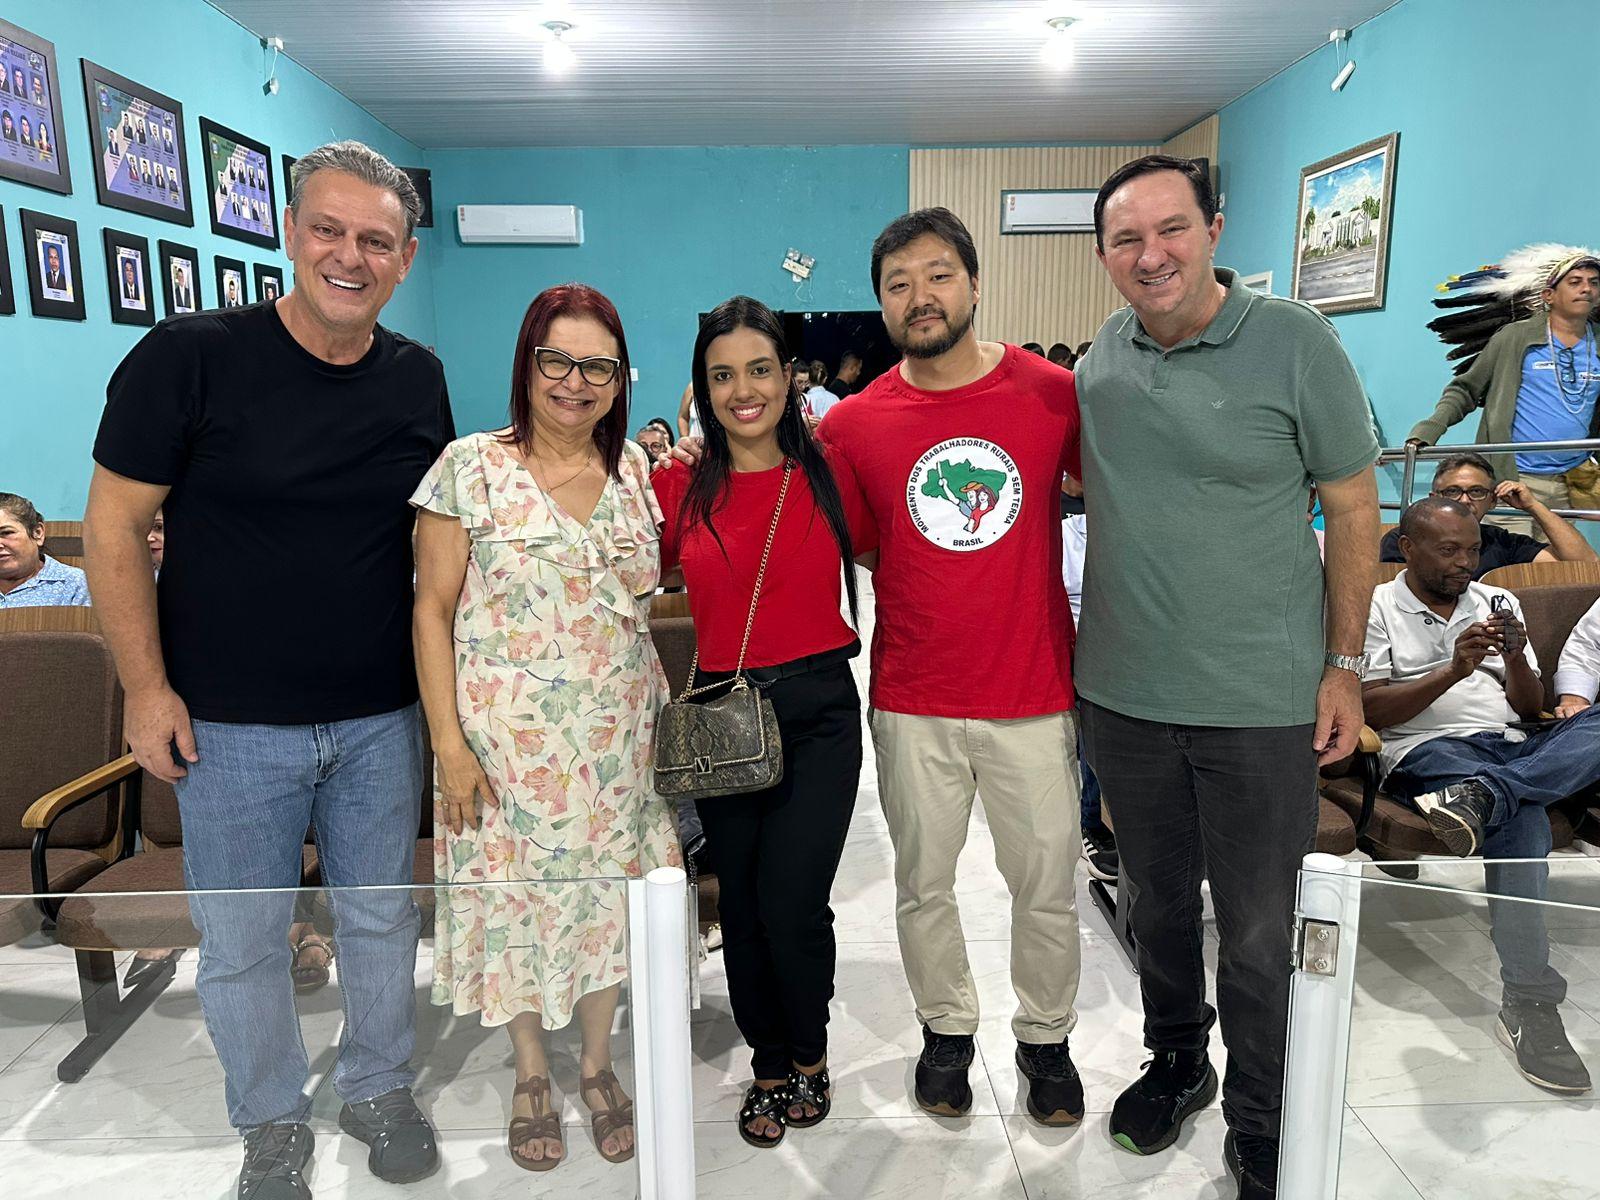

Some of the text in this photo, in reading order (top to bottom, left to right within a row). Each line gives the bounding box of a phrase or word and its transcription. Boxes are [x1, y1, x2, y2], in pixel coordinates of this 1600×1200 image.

[908, 439, 1021, 533] MOVIMENTO DOS TRABALHADORES RURAIS SEM TERRA
[953, 537, 984, 547] BRASIL
[697, 757, 708, 772] V
